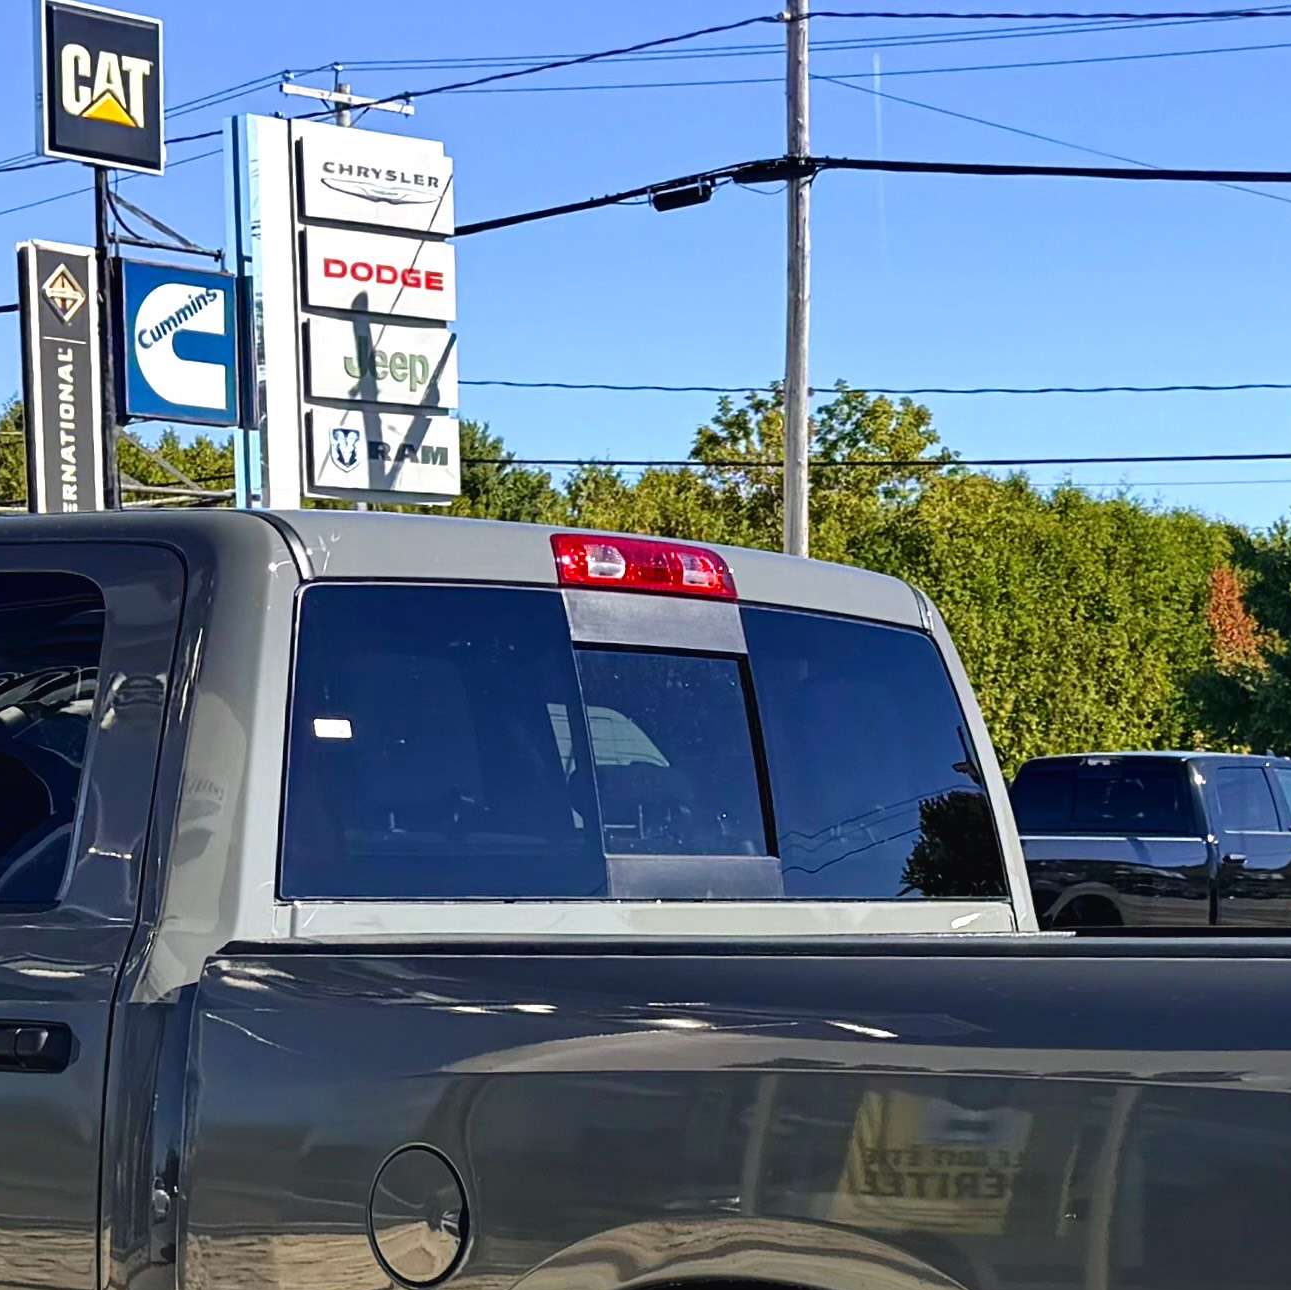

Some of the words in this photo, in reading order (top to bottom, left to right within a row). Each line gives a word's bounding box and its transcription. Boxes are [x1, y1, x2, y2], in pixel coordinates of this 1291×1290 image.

[60, 42, 153, 129] CAT
[321, 160, 441, 189] CHRYSLER
[322, 256, 445, 291] DODGE
[137, 287, 218, 351] Cummins
[342, 345, 431, 392] Jeep
[368, 440, 450, 467] RAM
